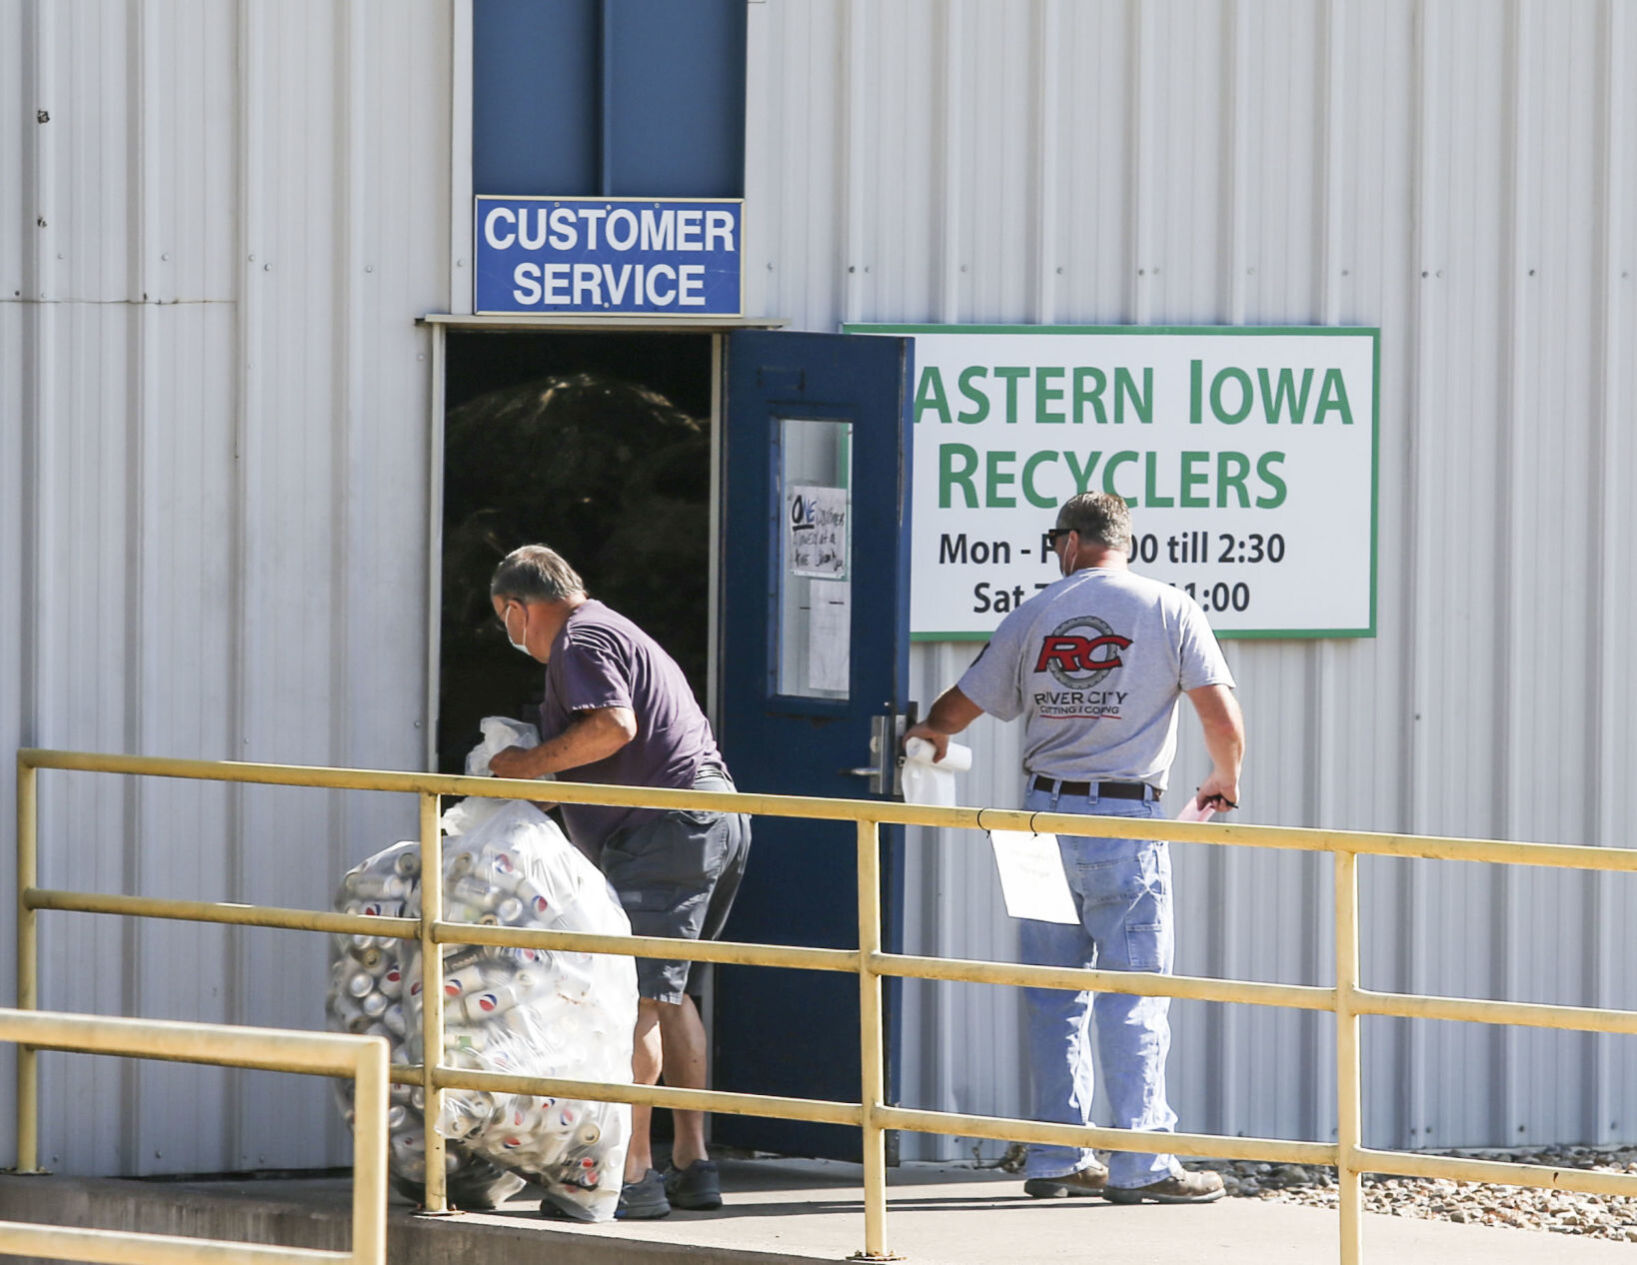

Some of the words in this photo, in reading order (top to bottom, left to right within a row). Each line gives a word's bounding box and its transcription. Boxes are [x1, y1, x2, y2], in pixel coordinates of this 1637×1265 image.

[484, 207, 736, 251] CUSTOMER
[513, 262, 706, 306] SERVICE
[913, 366, 1153, 424] ASTERN
[1190, 359, 1354, 425] IOWA
[938, 442, 1287, 509] RECYCLERS
[939, 533, 1011, 564] Mon
[1167, 531, 1208, 563] till
[1218, 533, 1285, 564] 2:30
[973, 582, 1025, 613] Sat
[1033, 635, 1134, 673] RC
[1034, 691, 1085, 705] RIVER
